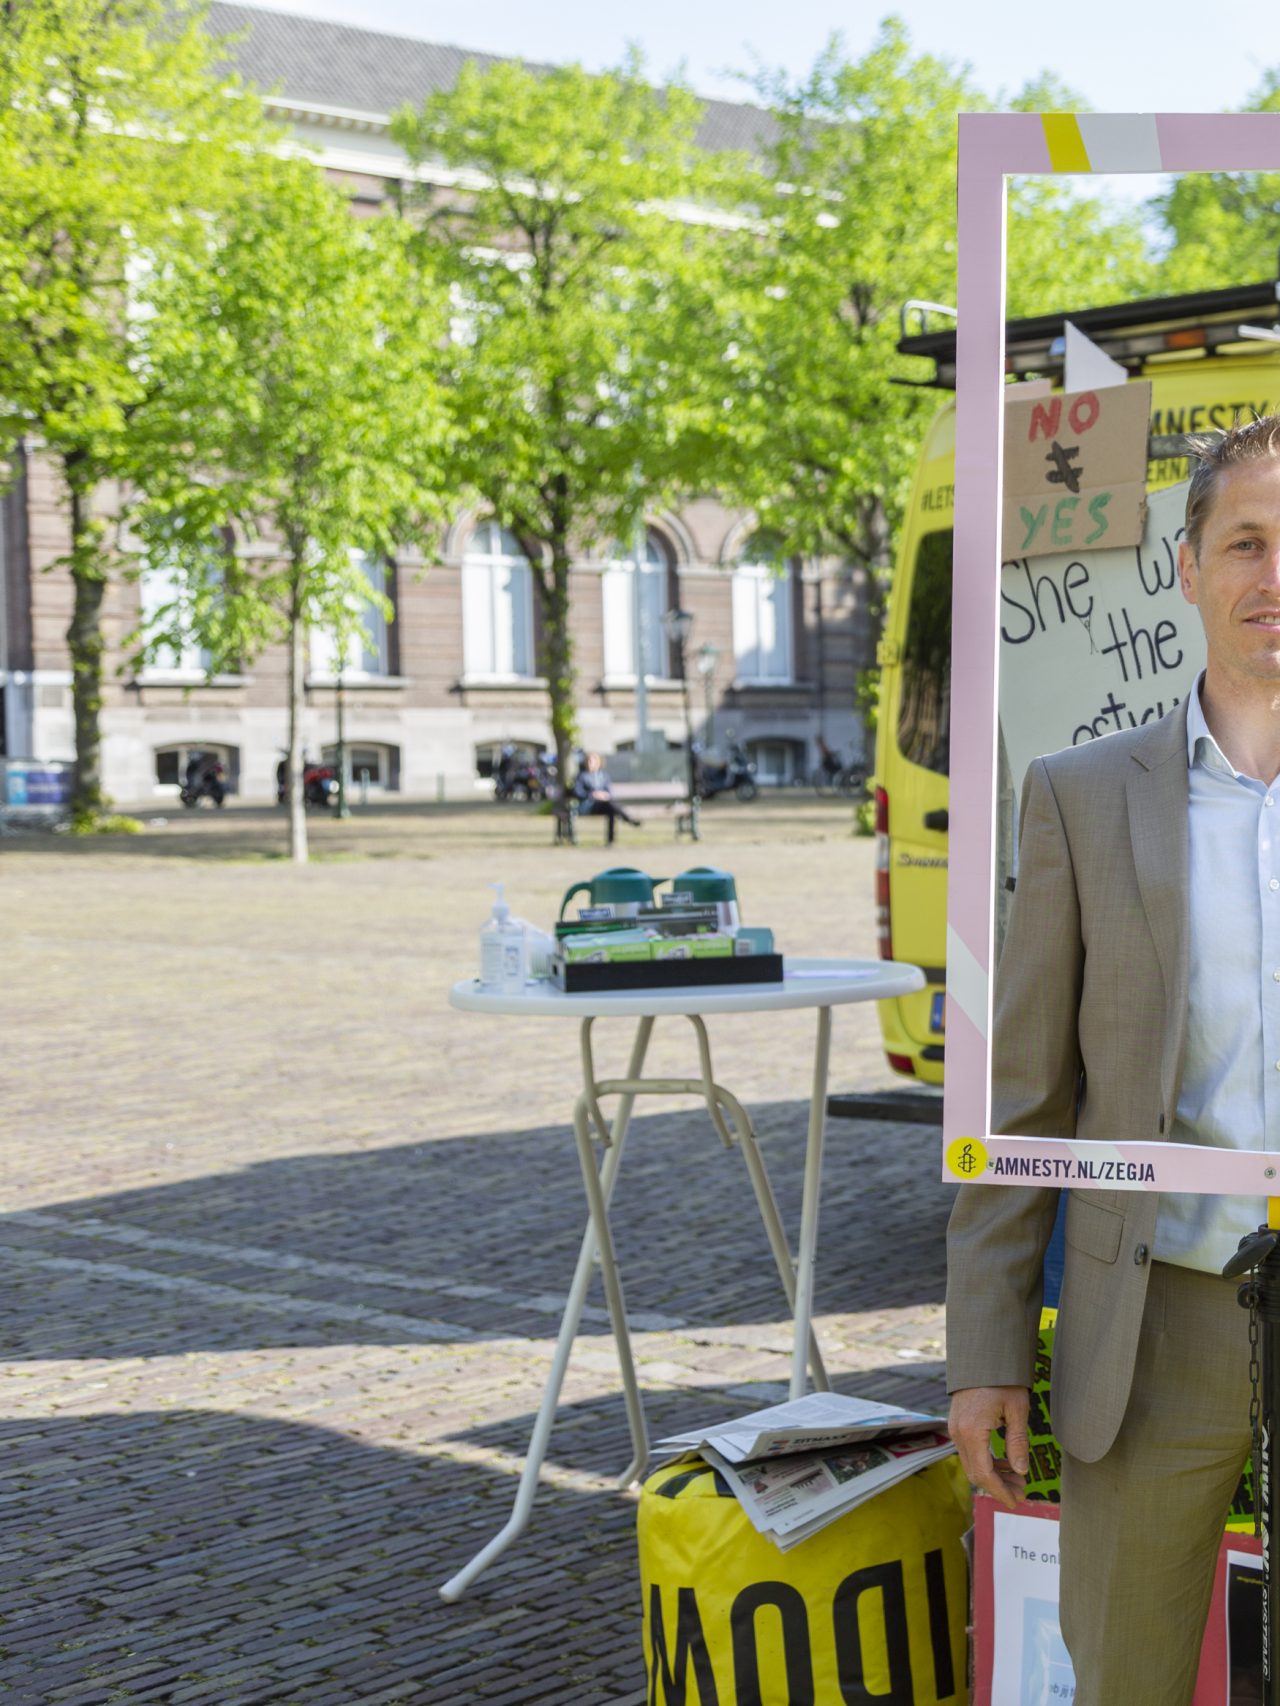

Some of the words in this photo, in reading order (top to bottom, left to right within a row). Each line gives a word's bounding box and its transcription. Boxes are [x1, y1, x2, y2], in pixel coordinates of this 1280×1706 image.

[1027, 390, 1100, 442] NO
[1018, 491, 1115, 551] YES
[1101, 607, 1184, 683] the
[993, 1155, 1156, 1183] AMNESTY.NL/ZEGJA
[1012, 1545, 1037, 1562] The
